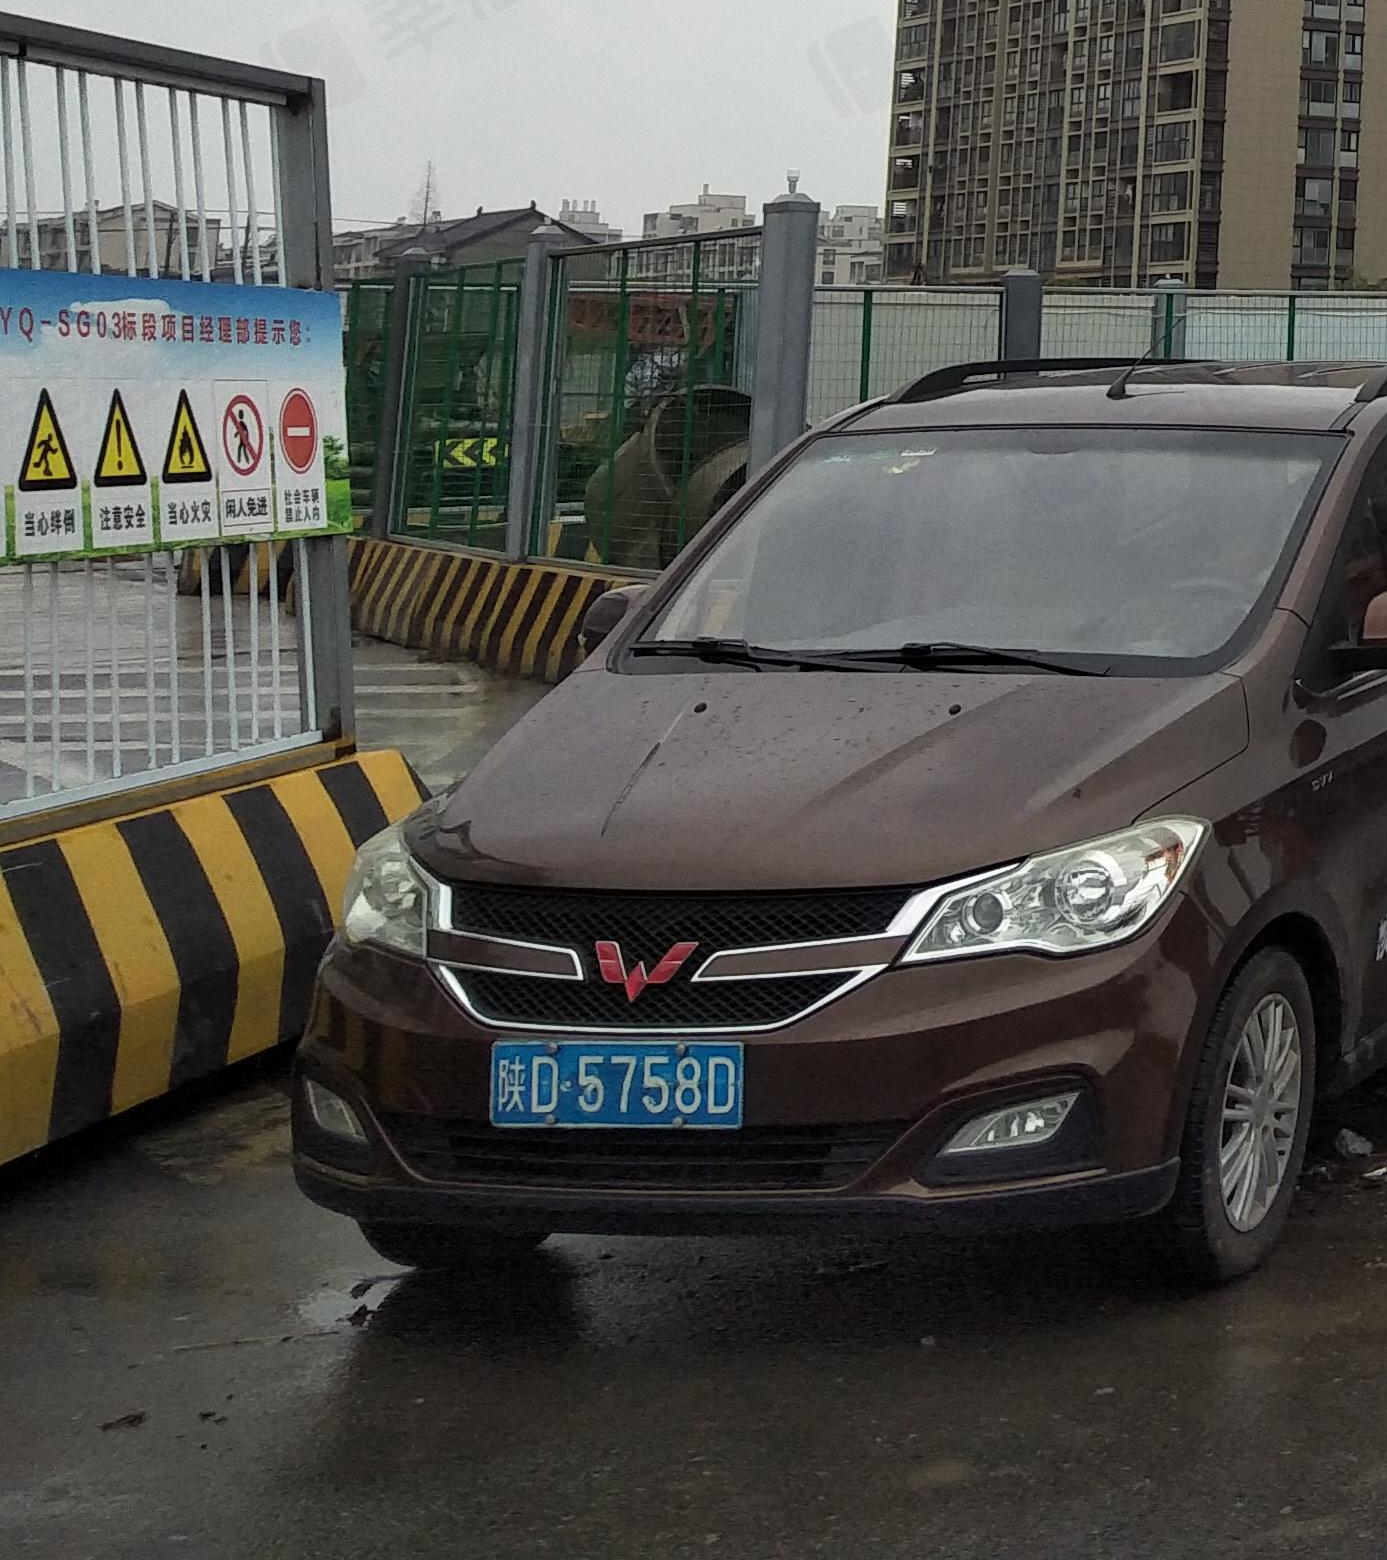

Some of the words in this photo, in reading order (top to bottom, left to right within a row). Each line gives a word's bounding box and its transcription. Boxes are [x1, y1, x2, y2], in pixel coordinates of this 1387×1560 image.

[99, 504, 146, 531] 注意安全
[167, 500, 212, 525] 当心火灾
[225, 497, 268, 518] 闲人免进
